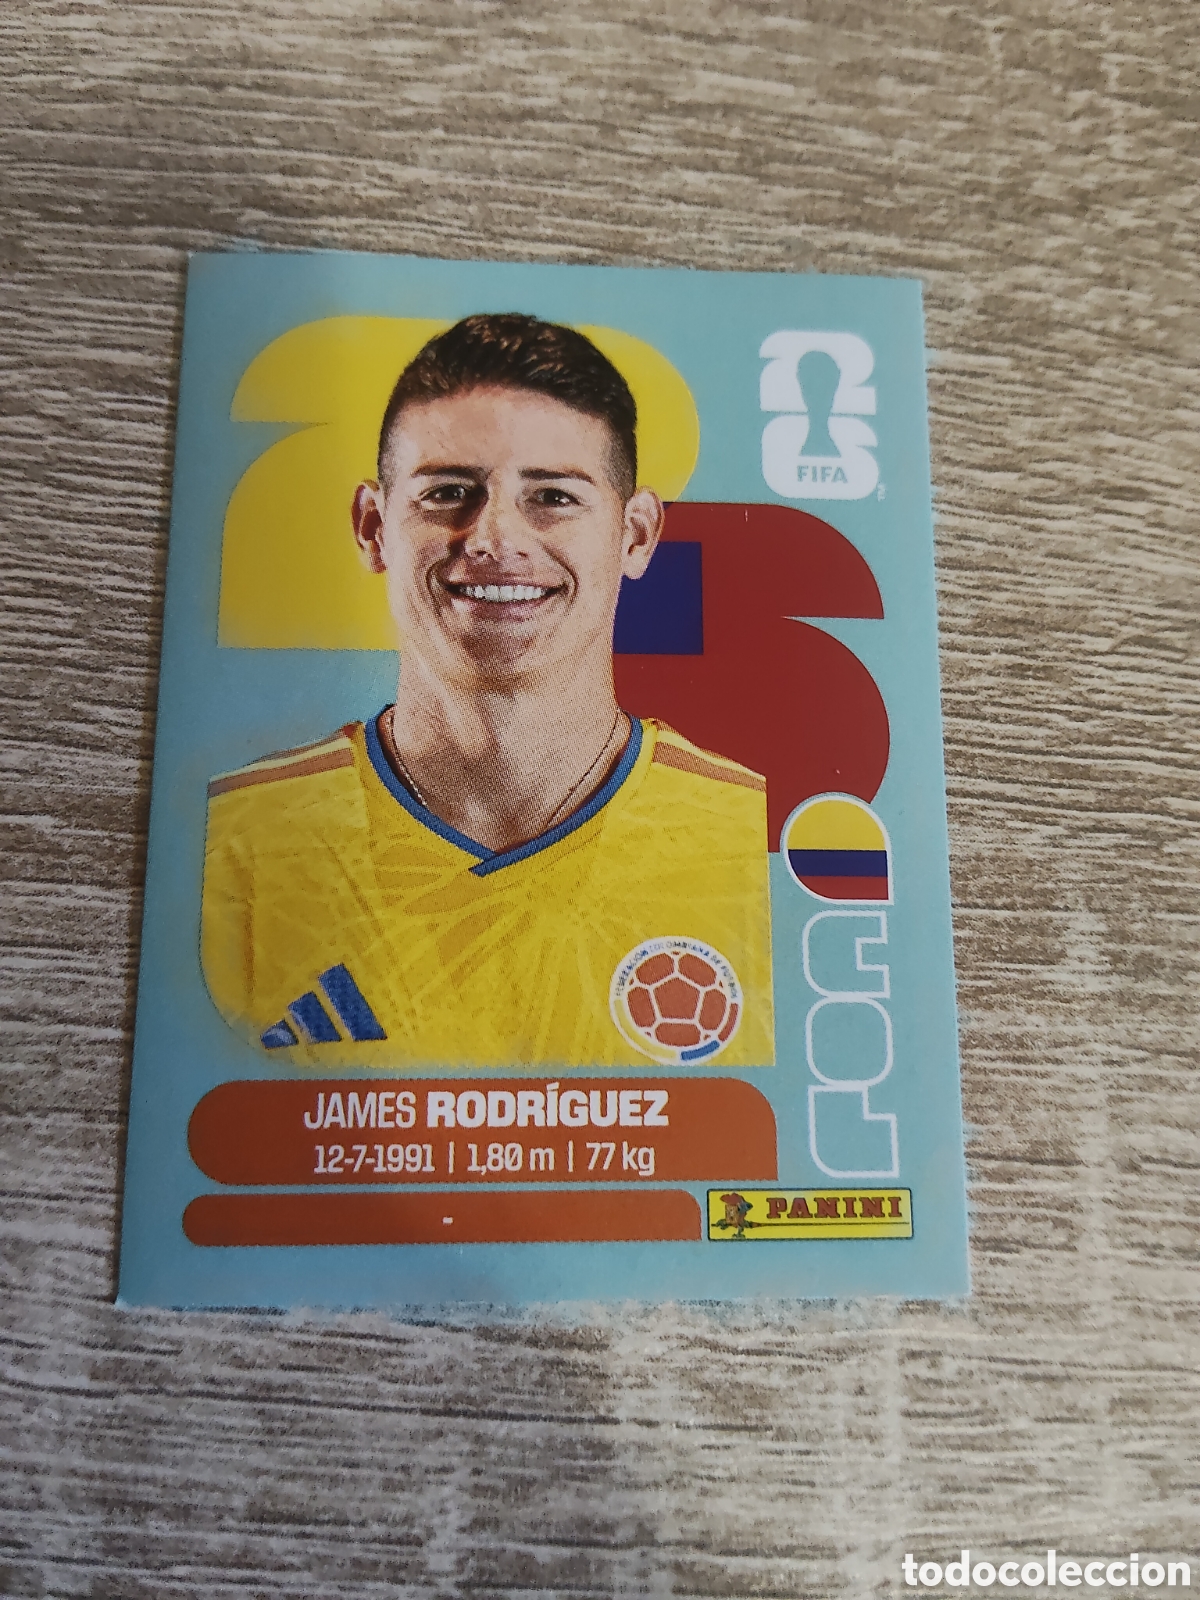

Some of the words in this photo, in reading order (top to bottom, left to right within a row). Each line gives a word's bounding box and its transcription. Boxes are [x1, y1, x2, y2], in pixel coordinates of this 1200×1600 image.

[796, 465, 848, 484] FIFA
[304, 1091, 416, 1130] JAMES
[427, 1082, 669, 1128] RODRÍGUEZ
[313, 1144, 436, 1173] 12-7-1991
[467, 1142, 523, 1176] 1,80
[530, 1147, 555, 1172] m
[586, 1142, 616, 1171] 77
[622, 1141, 656, 1176] kg
[766, 1196, 903, 1220] PANINI
